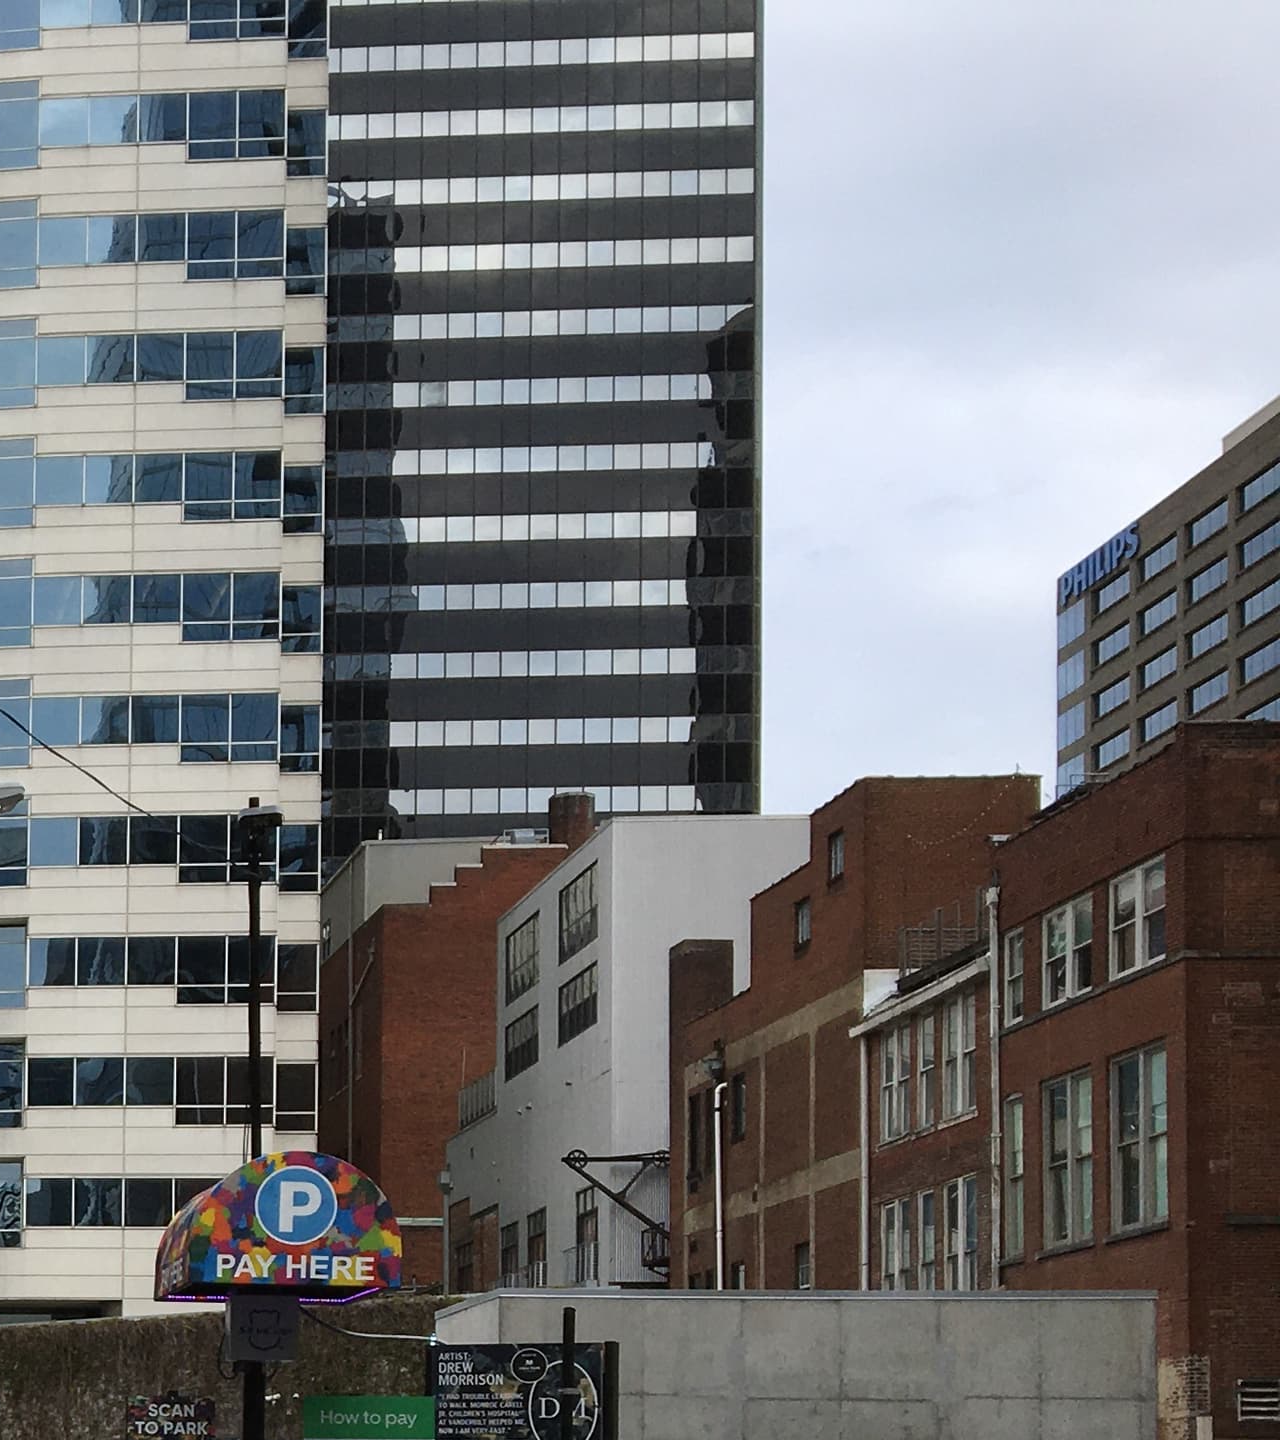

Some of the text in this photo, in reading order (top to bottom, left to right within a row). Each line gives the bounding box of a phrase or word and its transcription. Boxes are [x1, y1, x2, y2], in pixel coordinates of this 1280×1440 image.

[1059, 523, 1138, 604] PHILIPS
[278, 1181, 322, 1233] P
[216, 1254, 375, 1281] PAY HERE
[438, 1352, 471, 1361] ARTIST:
[438, 1362, 474, 1374] DREW
[438, 1374, 504, 1386] MORRISON
[148, 1403, 195, 1417] SCAN
[320, 1410, 417, 1429] How to pay
[135, 1421, 208, 1436] TO PARK
